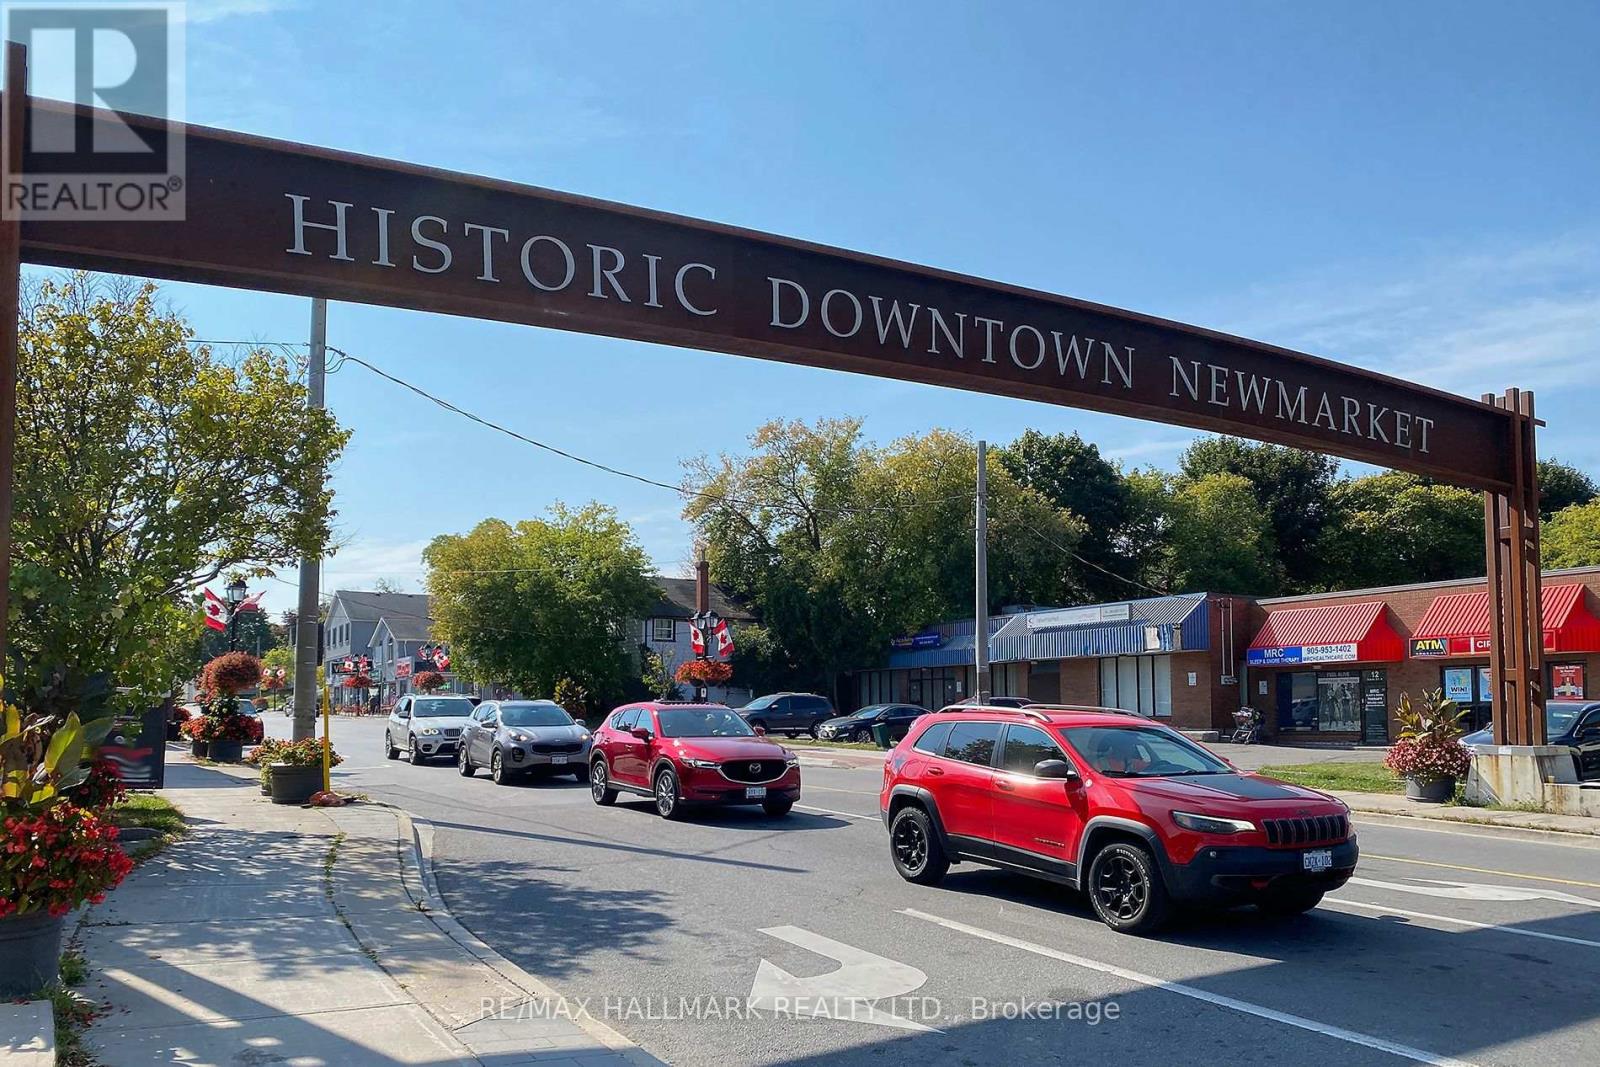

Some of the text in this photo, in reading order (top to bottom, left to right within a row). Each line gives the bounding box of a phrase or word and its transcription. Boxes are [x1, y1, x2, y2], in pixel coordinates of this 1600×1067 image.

[284, 193, 1435, 454] HISTORIC DOWNTOWN NEWMARKET
[1306, 645, 1352, 654] 905-953-1402
[1415, 640, 1443, 650] ATM
[1264, 648, 1285, 658] MRC
